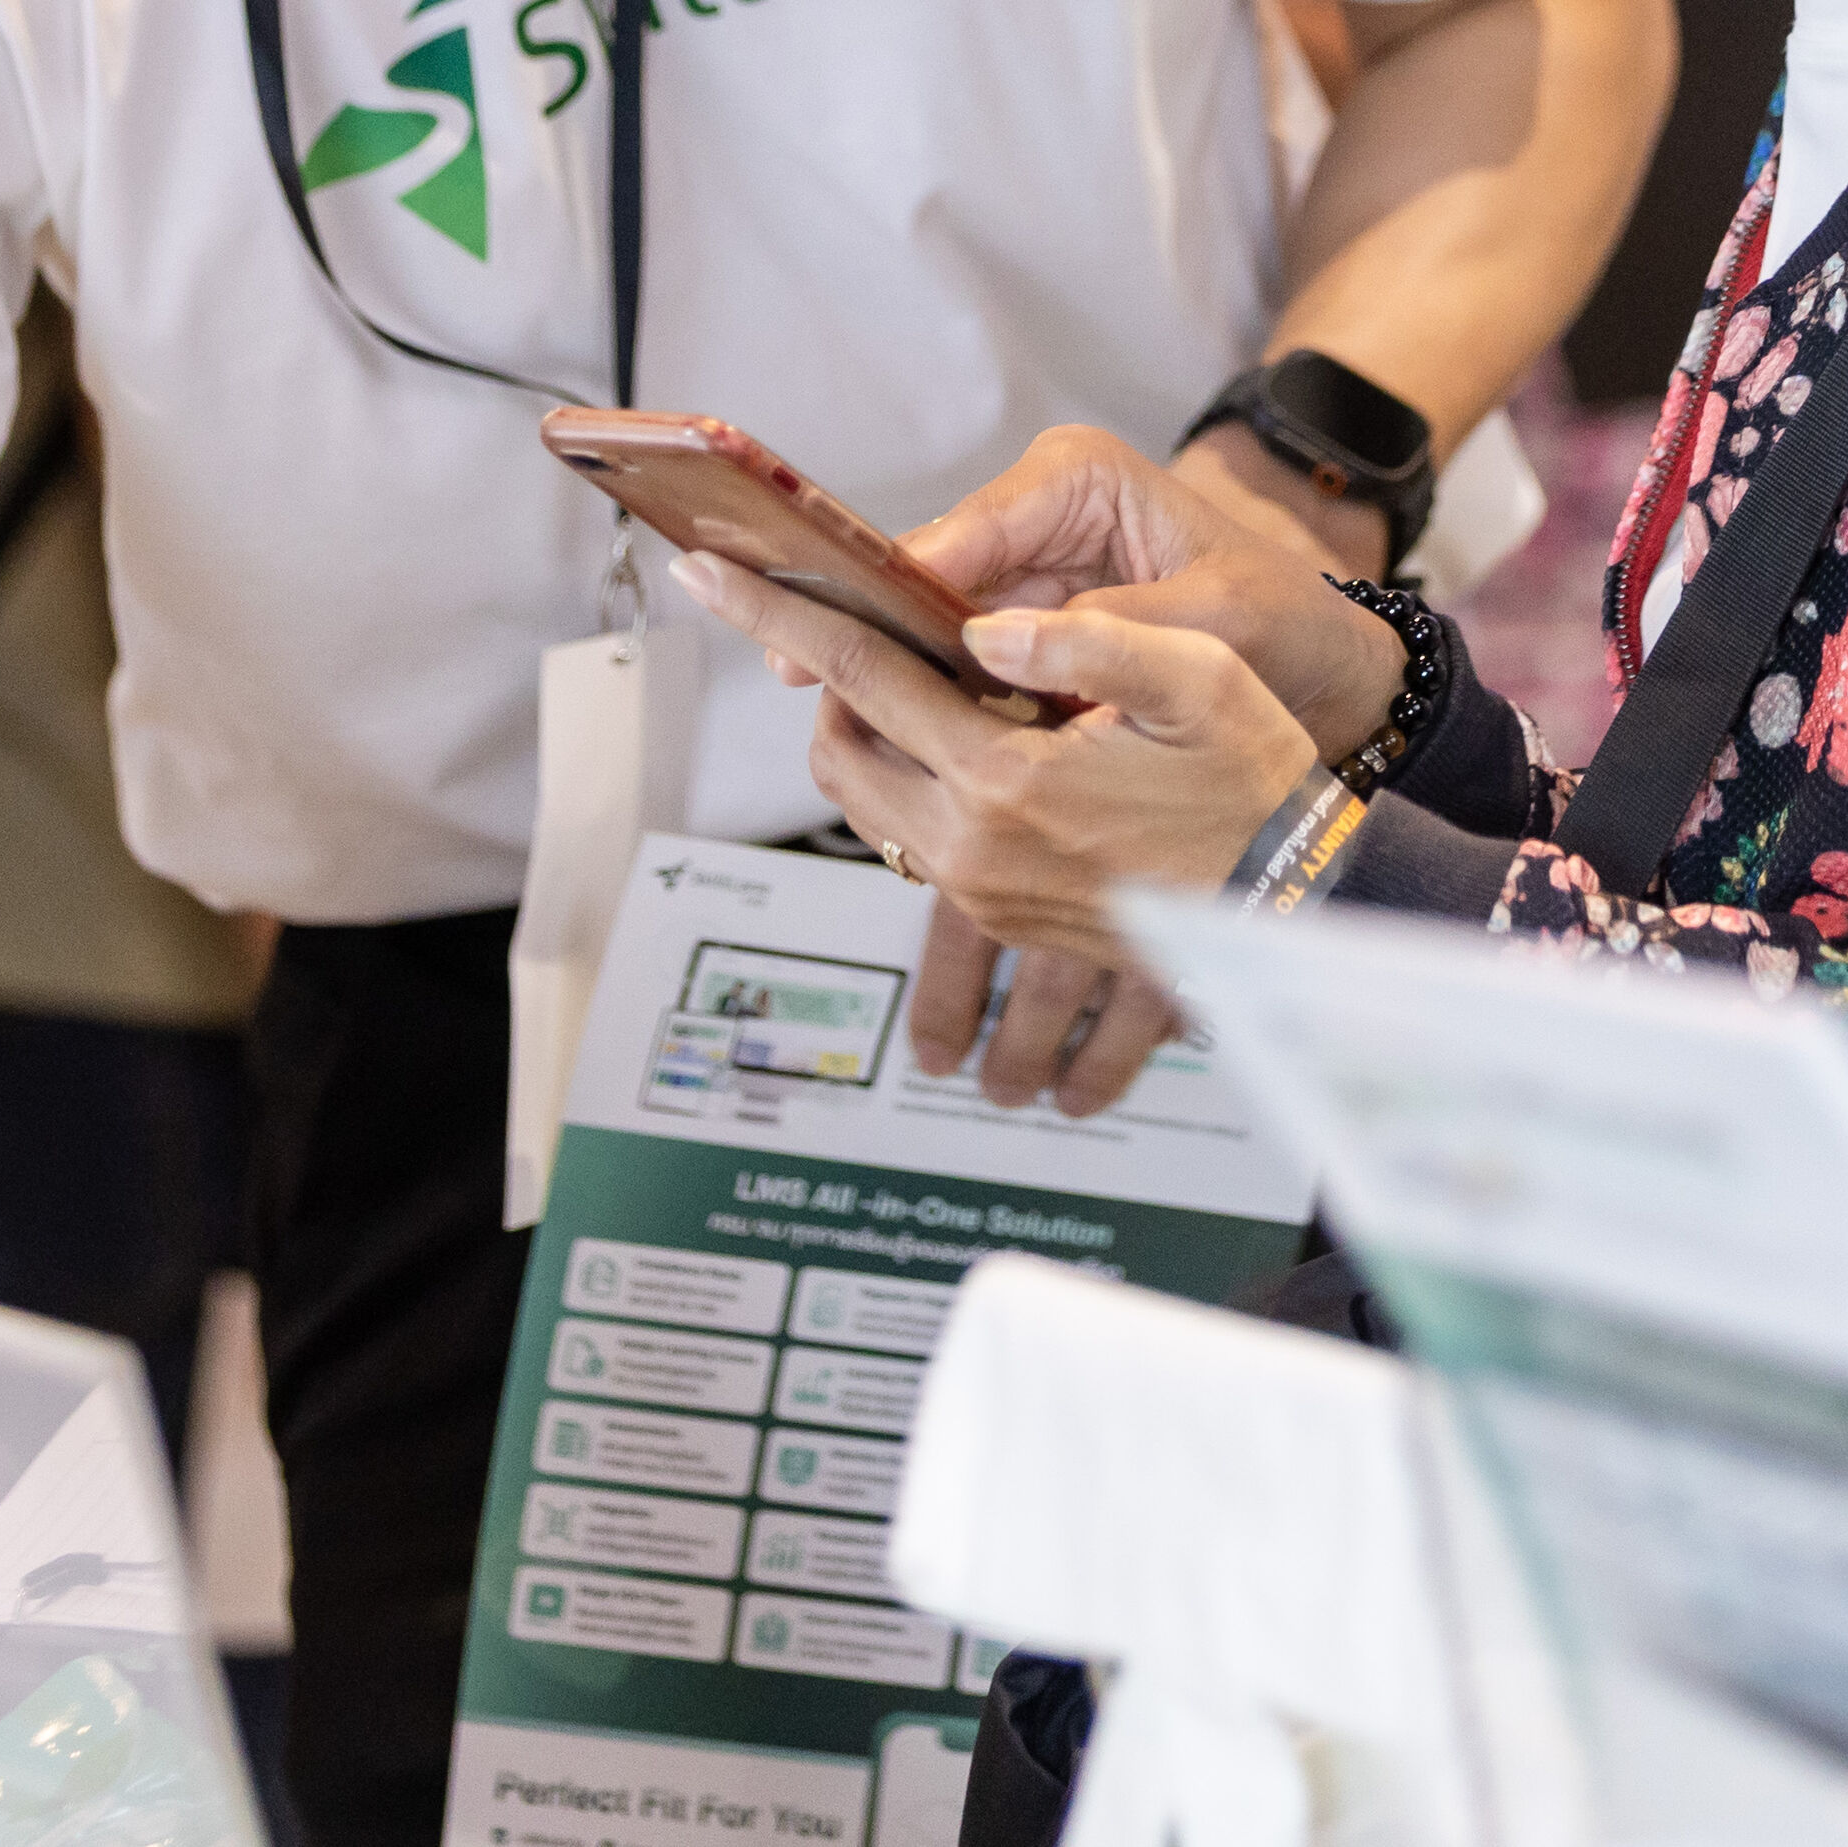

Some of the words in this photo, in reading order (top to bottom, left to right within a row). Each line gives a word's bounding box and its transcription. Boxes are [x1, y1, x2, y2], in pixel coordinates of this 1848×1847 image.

[1275, 882, 1305, 915] TO
[735, 1172, 810, 1209] LMS
[810, 1181, 859, 1214] All
[985, 1204, 1115, 1249] Solution
[493, 1770, 631, 1817] Perfect
[638, 1786, 689, 1822] Fit
[696, 1793, 756, 1829] For
[772, 1802, 844, 1841] You
